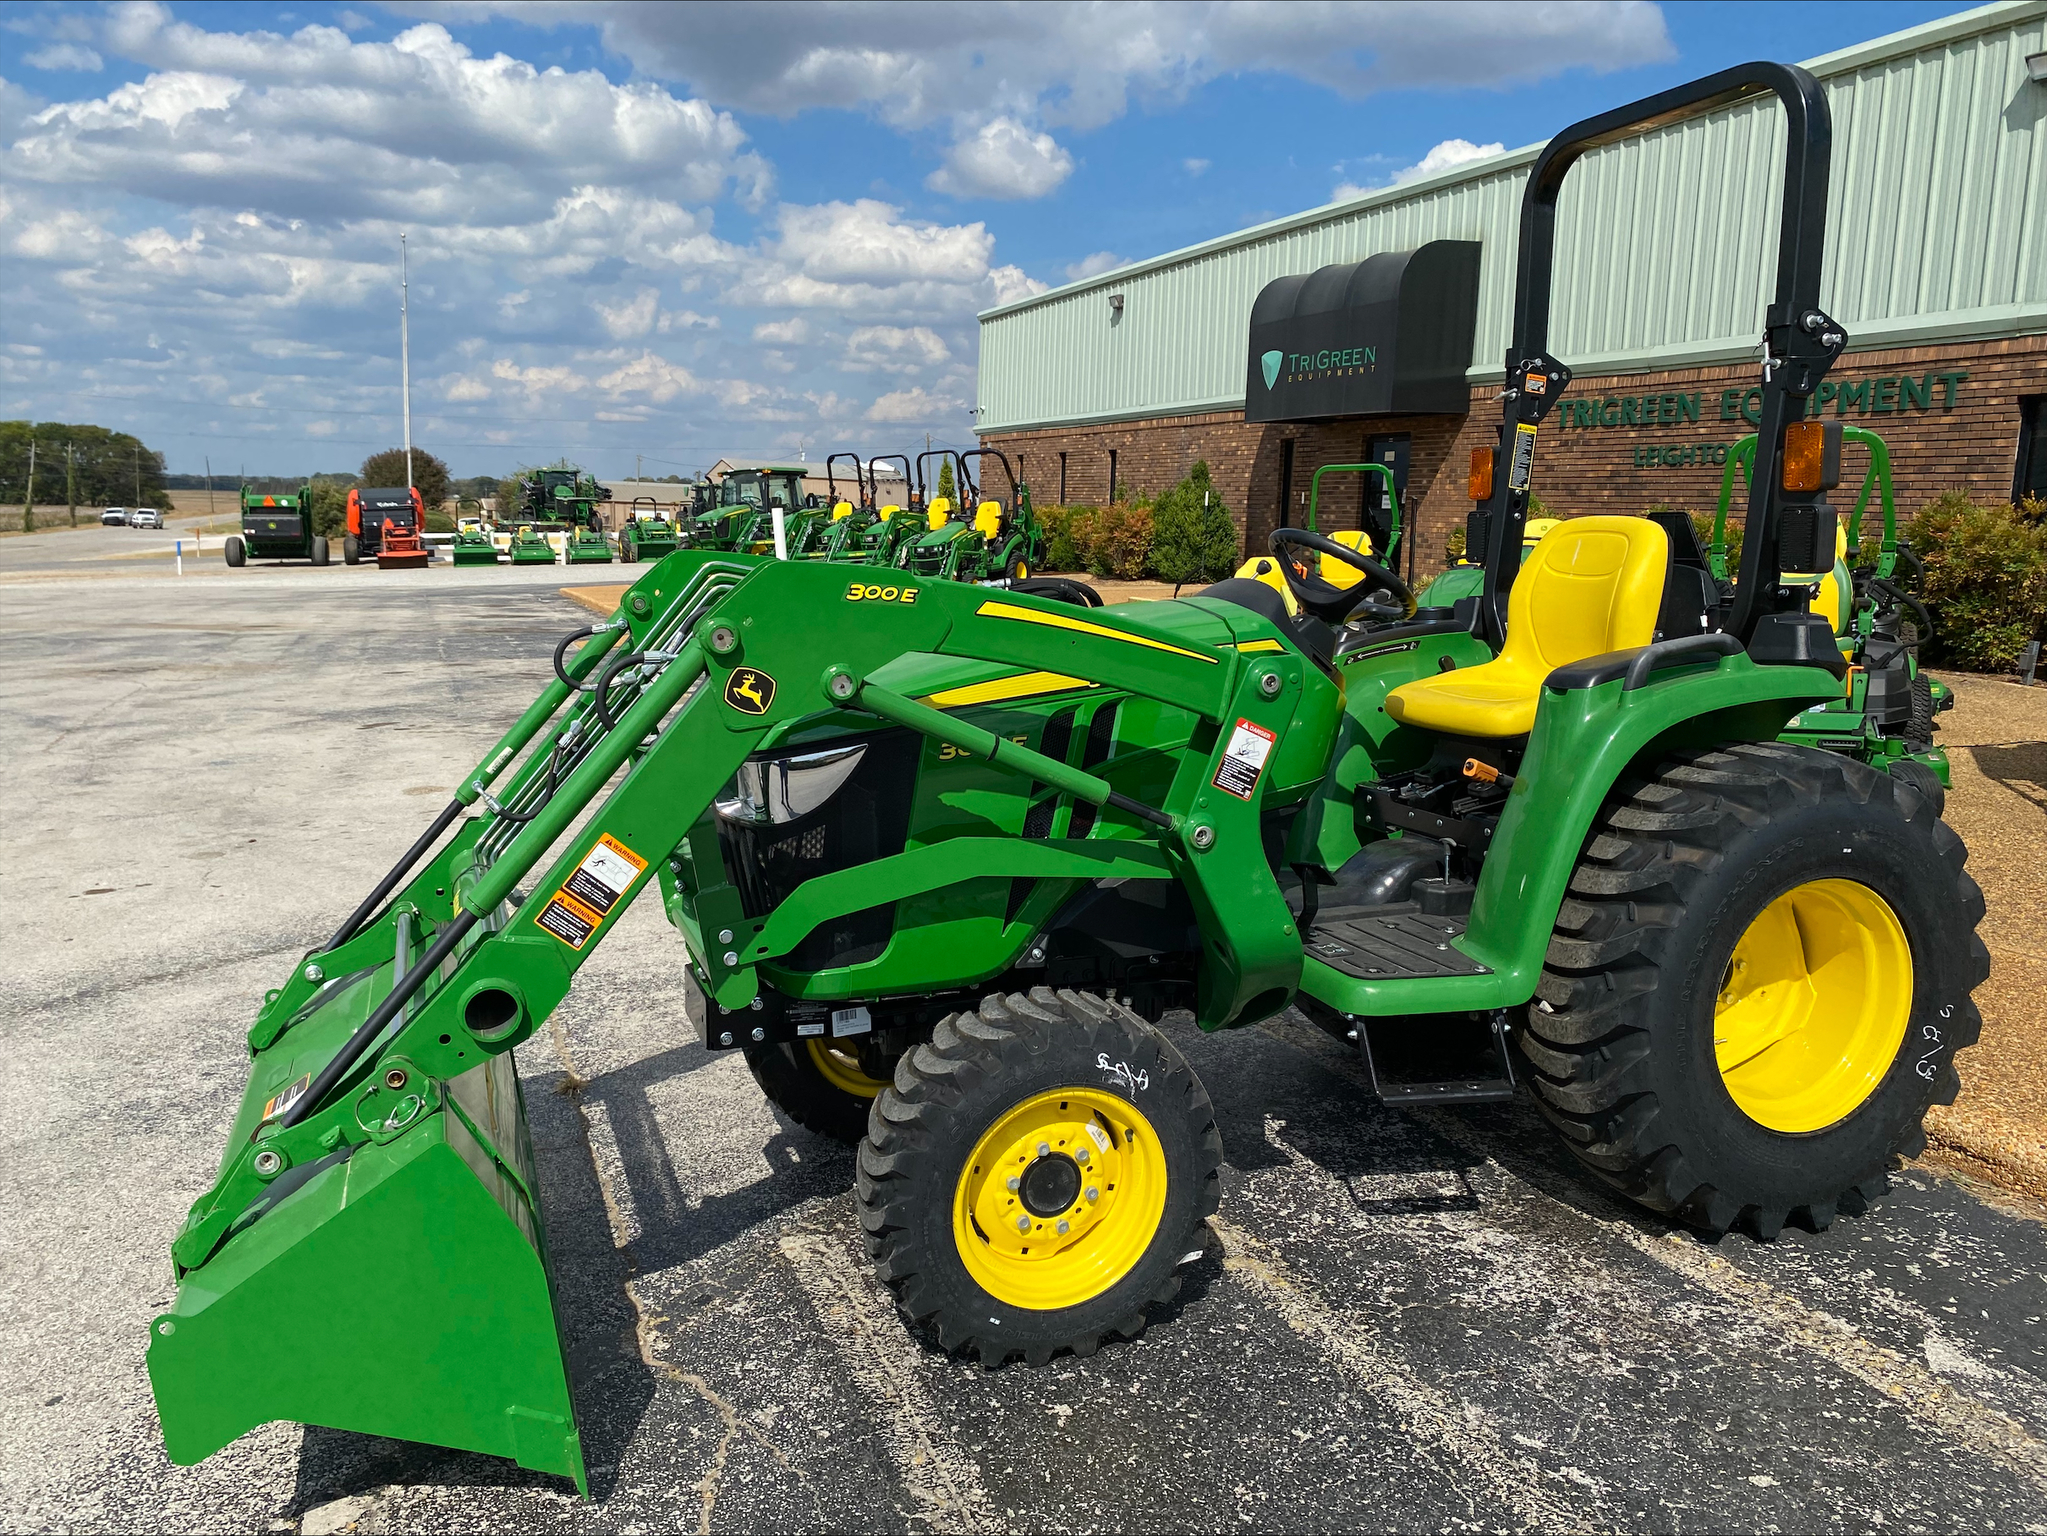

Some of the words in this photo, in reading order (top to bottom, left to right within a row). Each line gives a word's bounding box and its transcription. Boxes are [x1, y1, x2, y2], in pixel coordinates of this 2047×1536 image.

[1288, 365, 1375, 383] EQUIPMENT
[1556, 391, 1702, 427] TRIGREEN
[1720, 371, 1969, 425] EQPMENT
[1634, 443, 1746, 467] LEIGHTO
[1249, 725, 1272, 740] DANGER
[613, 843, 641, 866] WARNING
[567, 901, 595, 923] WARNING
[1681, 837, 1805, 1001] MARATHONER
